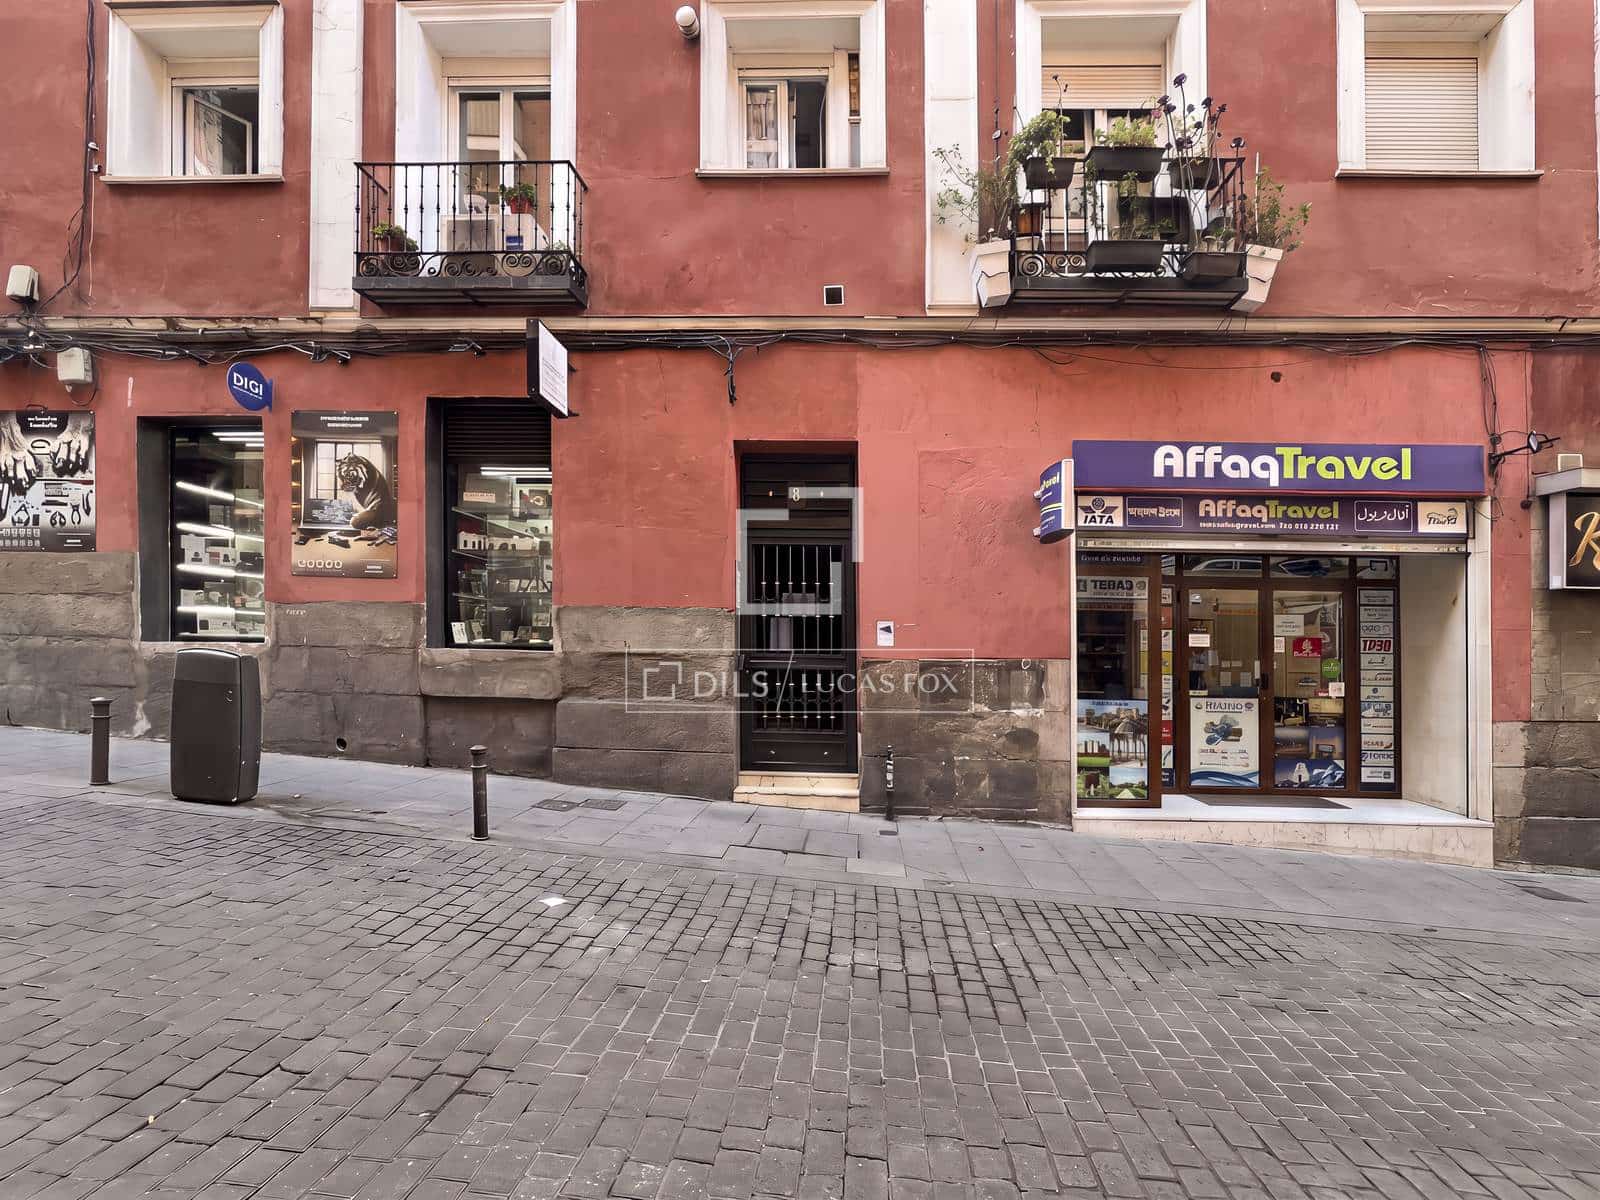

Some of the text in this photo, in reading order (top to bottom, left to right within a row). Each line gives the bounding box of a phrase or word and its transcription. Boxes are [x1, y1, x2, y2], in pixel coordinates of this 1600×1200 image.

[233, 371, 263, 396] DIGI
[1153, 445, 1412, 487] AffaqTravel
[792, 487, 800, 502] 8
[1083, 514, 1114, 525] IATA
[1199, 499, 1340, 523] AffaqTravel
